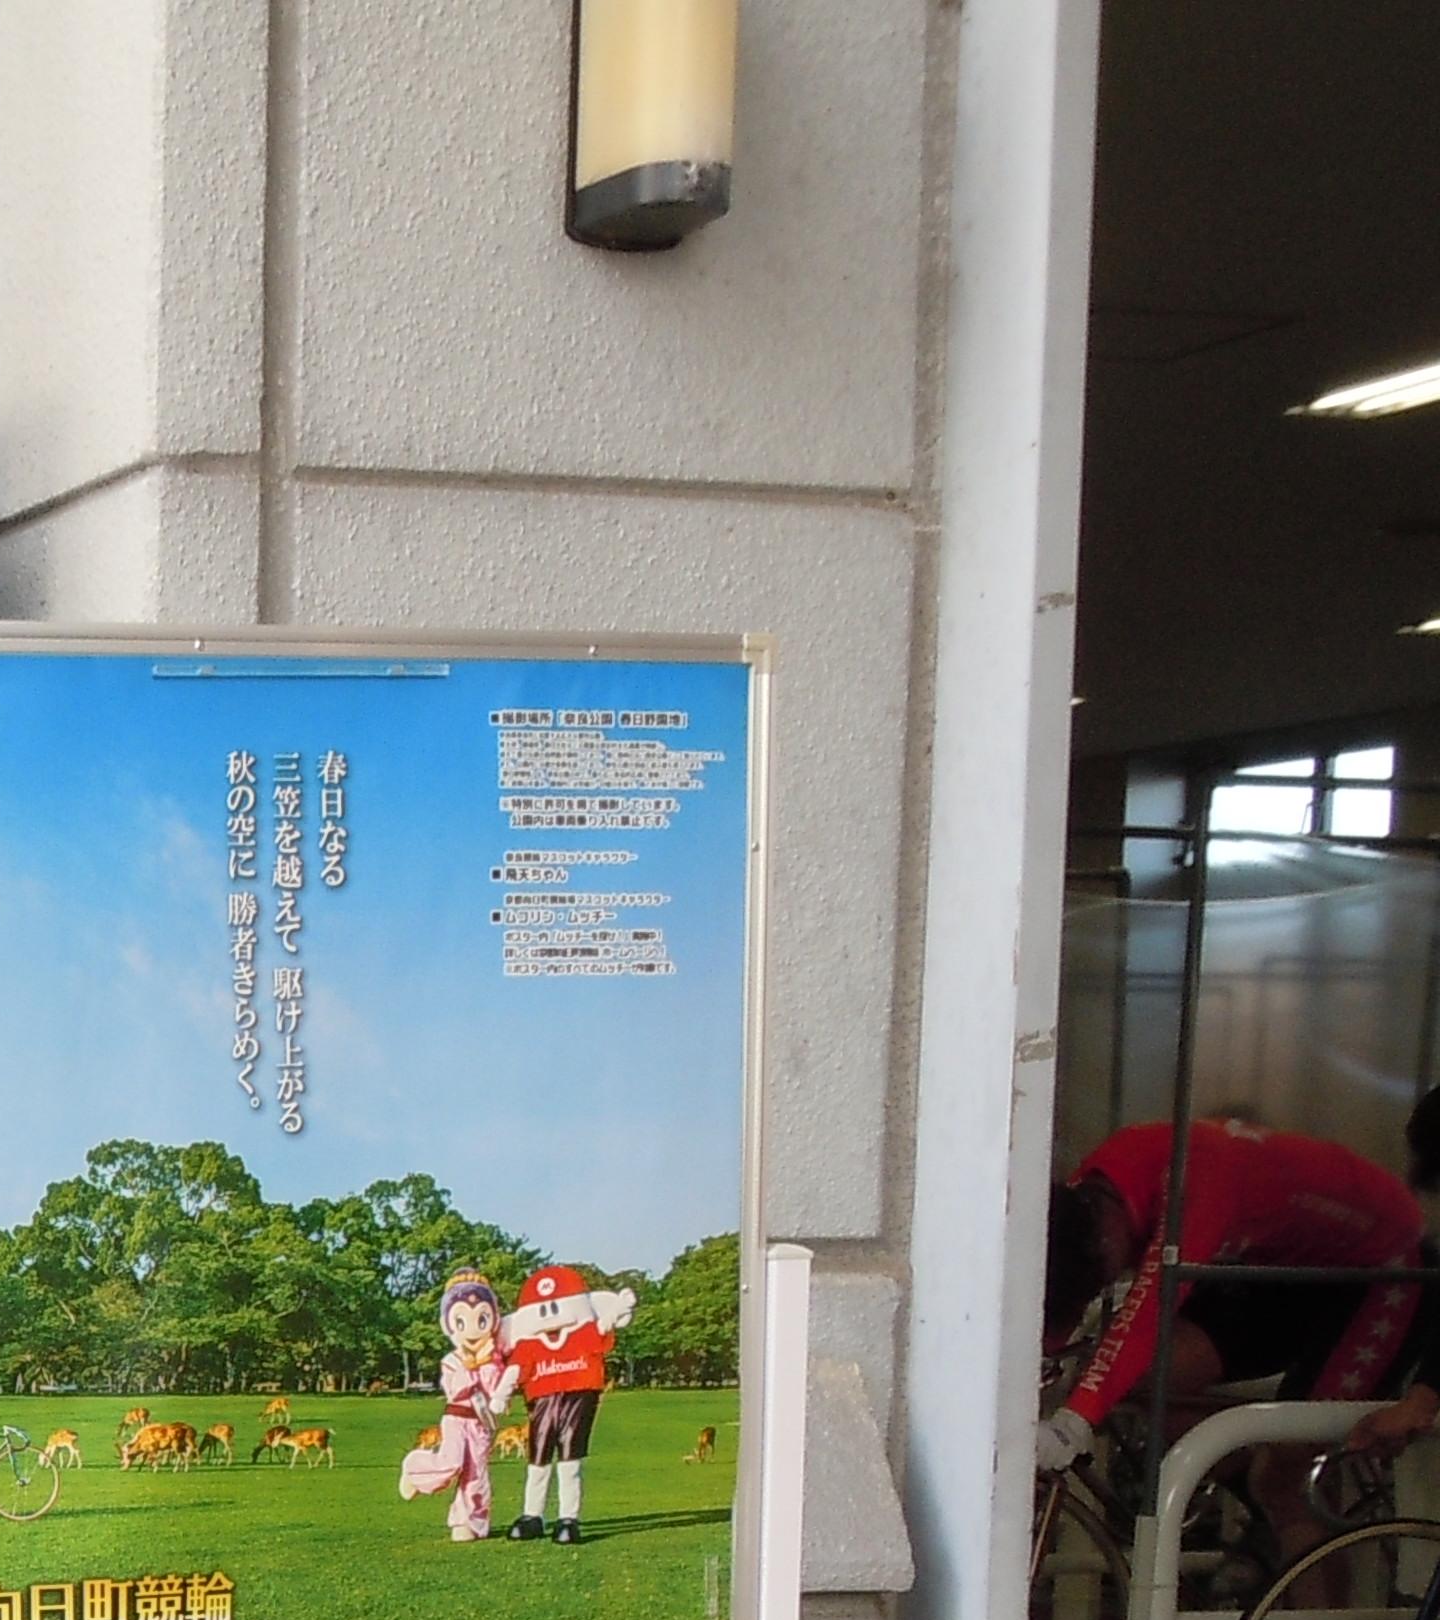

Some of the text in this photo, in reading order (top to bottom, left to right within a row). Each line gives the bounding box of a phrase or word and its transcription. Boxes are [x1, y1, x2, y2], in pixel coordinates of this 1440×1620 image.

[226, 750, 261, 1109] 秋の空に 勝者きらめく。
[272, 751, 305, 1133] 三笠を越えて 駆け上がる
[317, 750, 348, 887] 春日なる
[1079, 1338, 1125, 1394] TEAM
